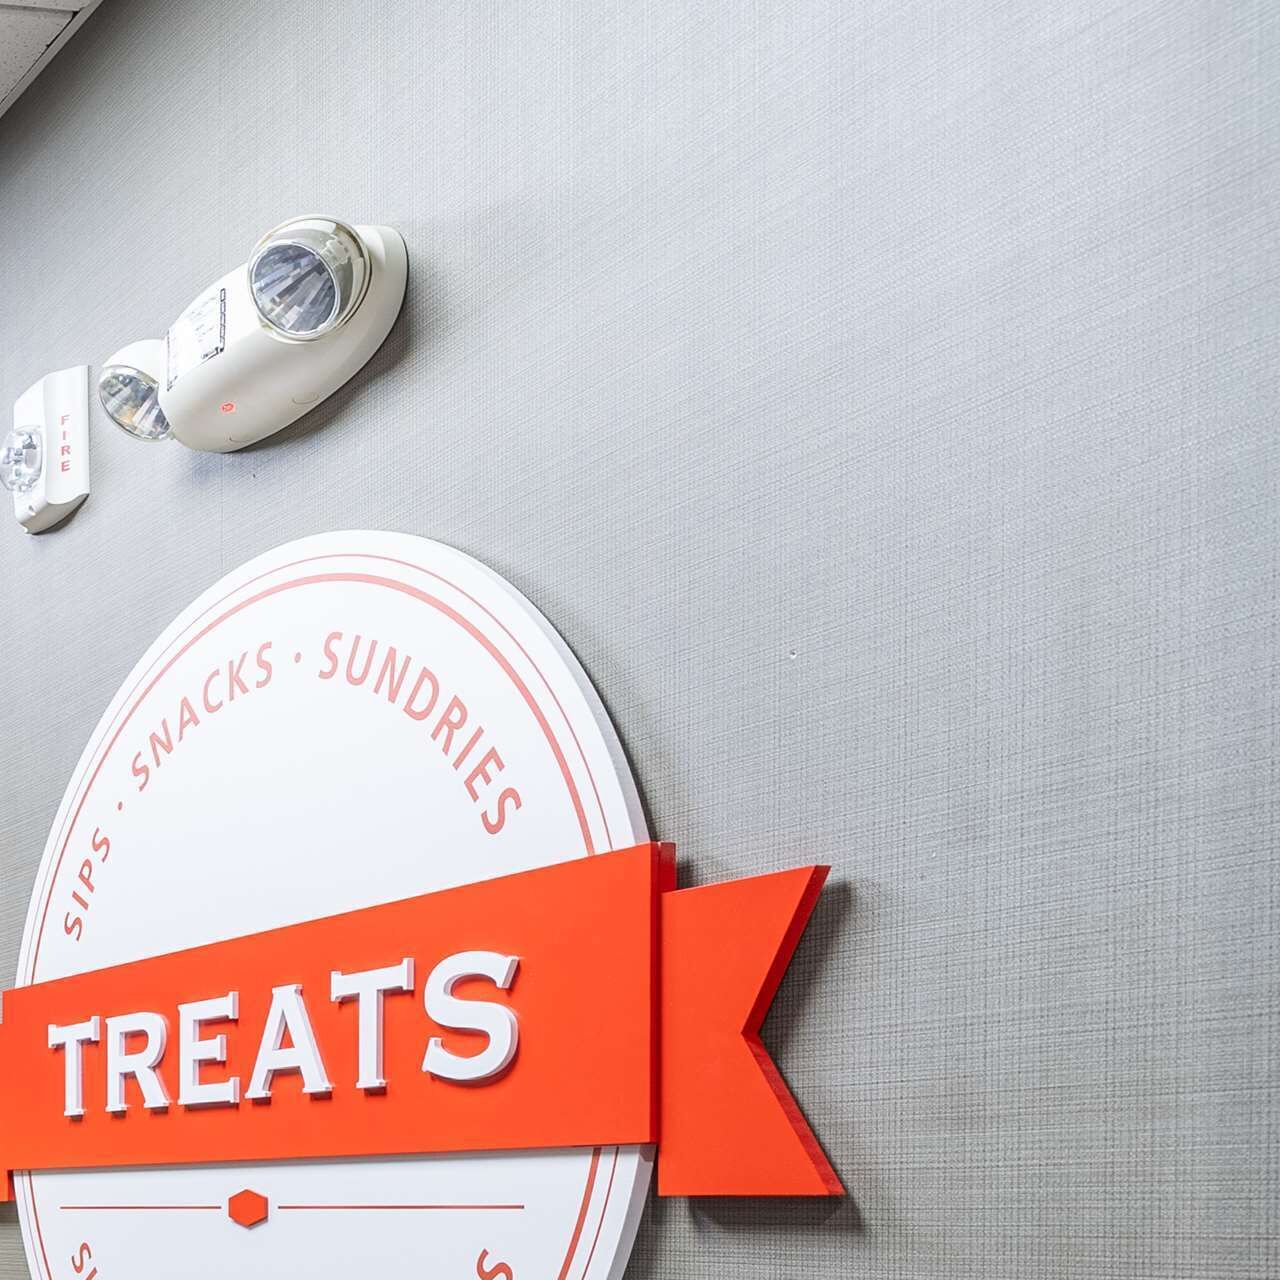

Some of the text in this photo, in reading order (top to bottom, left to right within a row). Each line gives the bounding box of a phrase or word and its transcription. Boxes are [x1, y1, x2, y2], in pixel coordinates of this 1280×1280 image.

[60, 414, 71, 473] FIRE
[62, 629, 524, 943] SIPS SNACKS SUNDRIES
[48, 948, 522, 1118] TREATS
